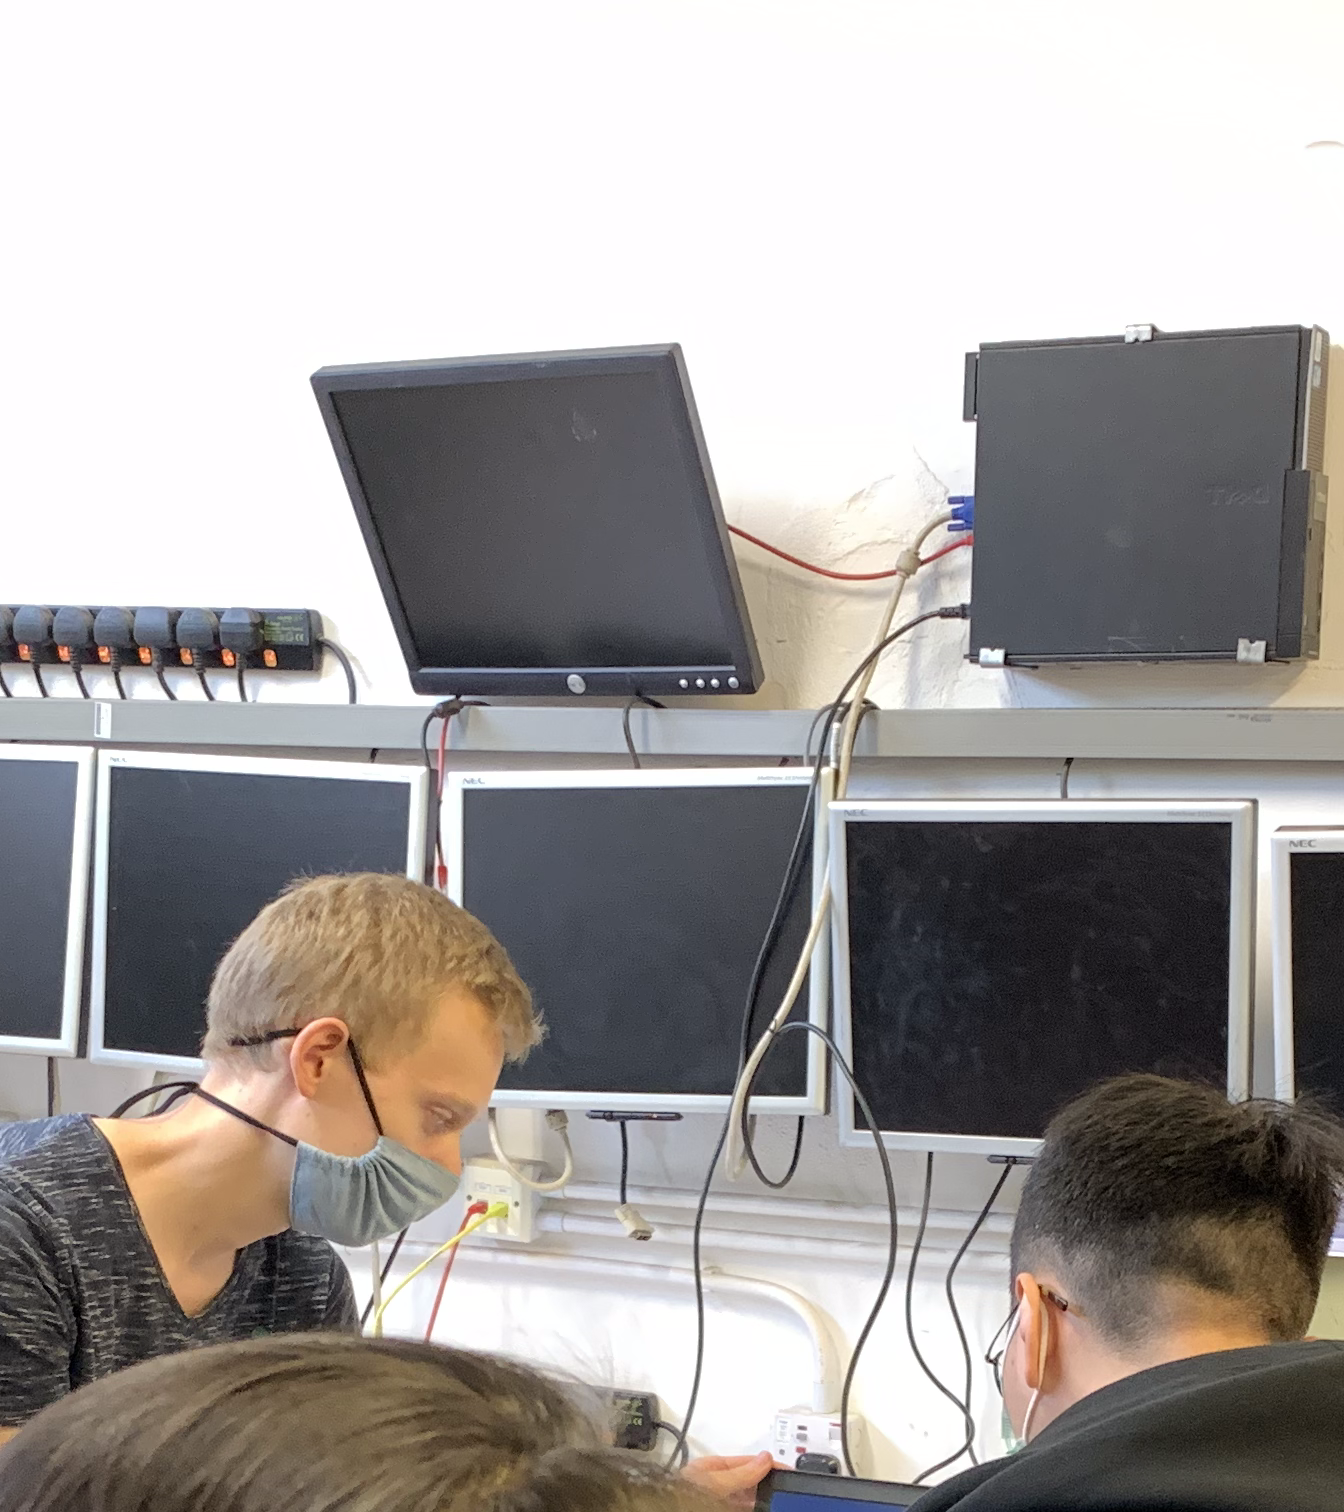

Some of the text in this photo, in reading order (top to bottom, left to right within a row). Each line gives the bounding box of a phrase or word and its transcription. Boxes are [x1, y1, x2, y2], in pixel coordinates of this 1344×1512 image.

[462, 777, 486, 785] NEC
[843, 809, 869, 817] NEC
[1288, 839, 1318, 848] NEC
